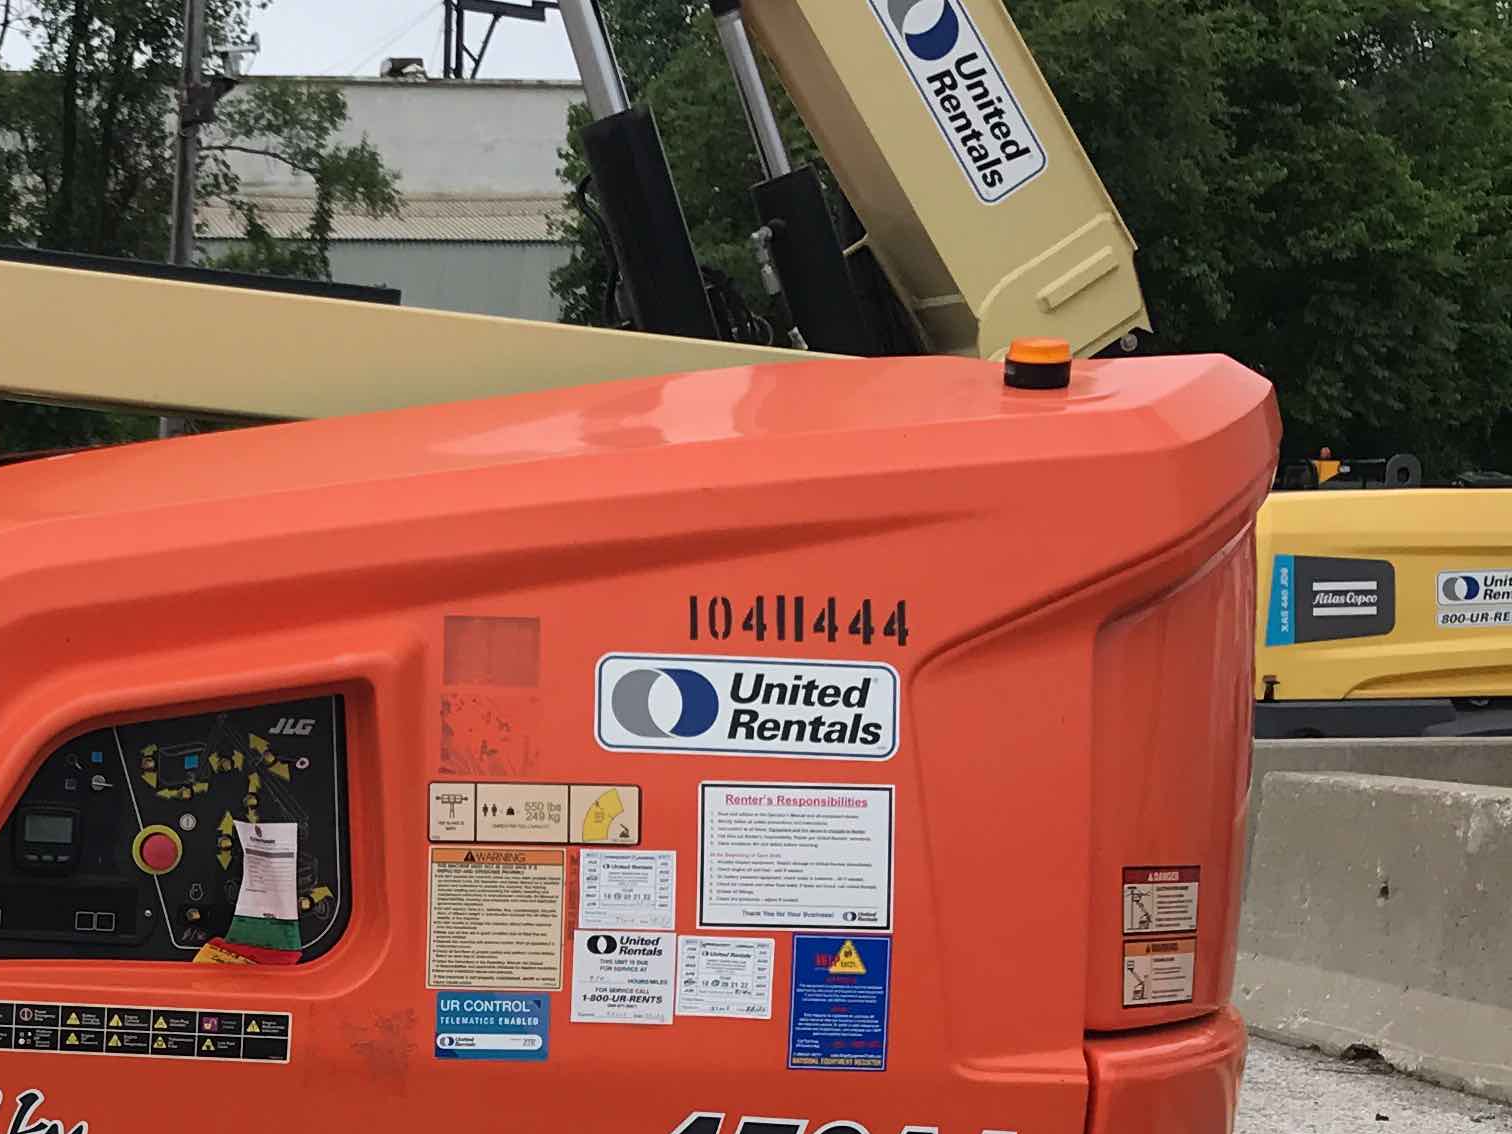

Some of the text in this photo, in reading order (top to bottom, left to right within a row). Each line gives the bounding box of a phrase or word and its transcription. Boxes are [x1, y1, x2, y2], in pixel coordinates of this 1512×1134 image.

[953, 52, 1031, 161] United
[926, 68, 1004, 188] Rentals
[1313, 592, 1378, 606] Atlas Copco
[1483, 589, 1512, 600] Ren
[689, 595, 909, 646] 10411444
[729, 672, 872, 708] United
[268, 717, 316, 736] JLG
[727, 708, 883, 746] Rentals
[725, 793, 869, 809] Renter's Responsibilities
[476, 852, 527, 863] WARNING
[619, 936, 661, 946] United
[619, 946, 663, 956] Rentals
[440, 1000, 530, 1012] UR CONTROL
[582, 994, 663, 1004] 1-800-UR-RENTS
[440, 1016, 539, 1025] TELEMATICS ENABLED
